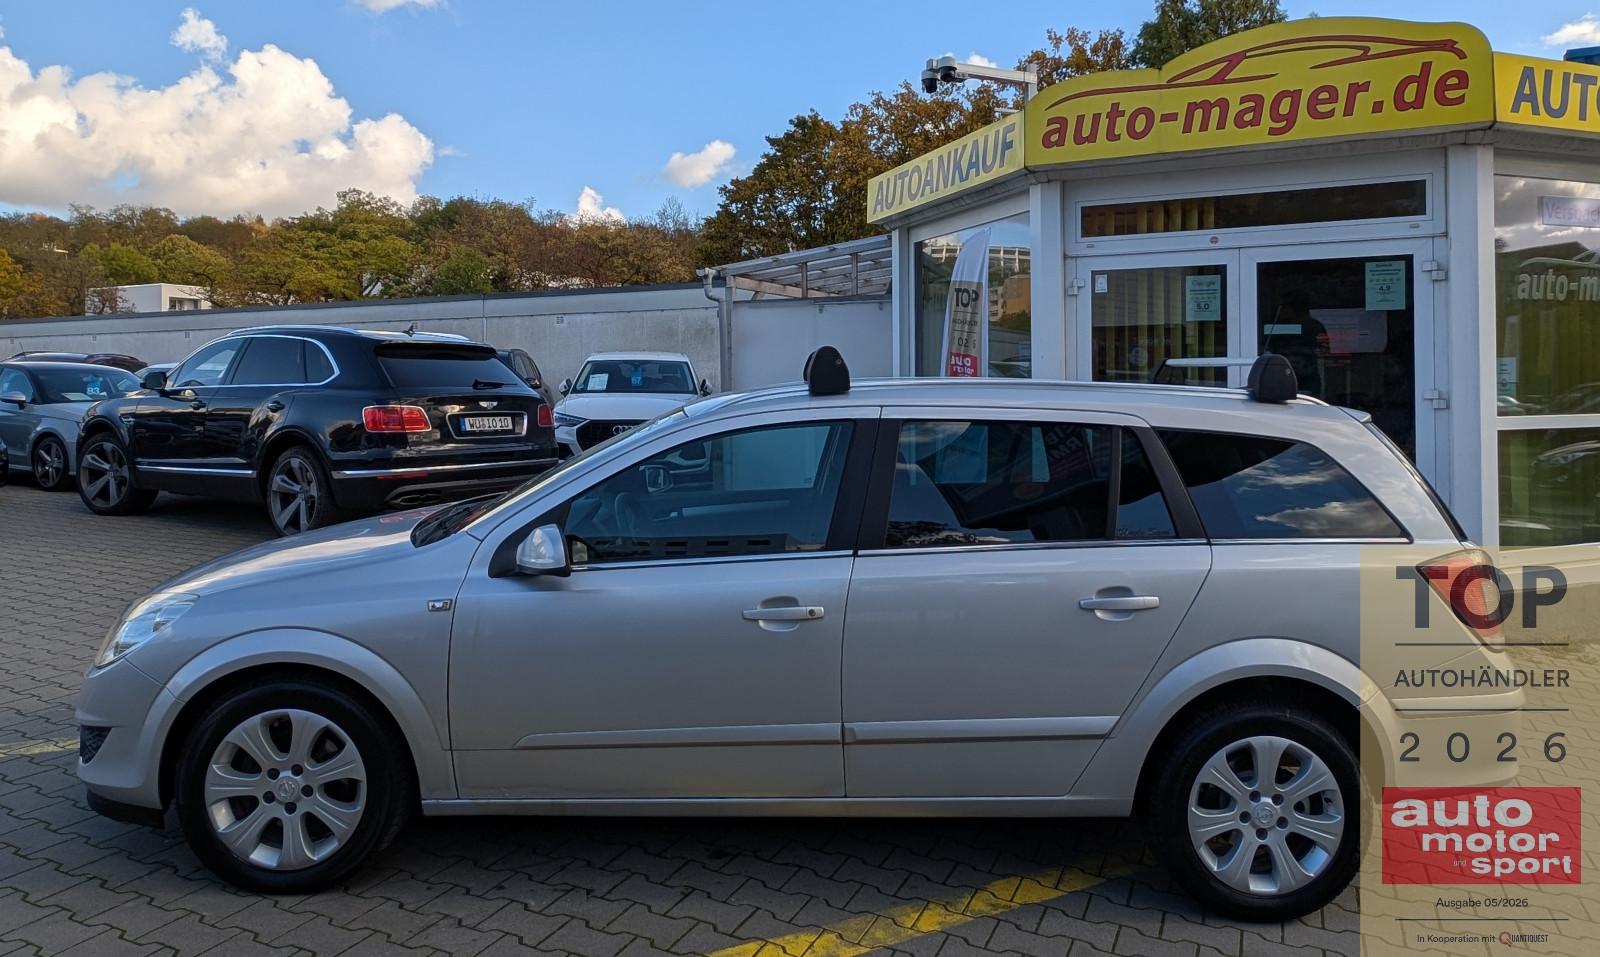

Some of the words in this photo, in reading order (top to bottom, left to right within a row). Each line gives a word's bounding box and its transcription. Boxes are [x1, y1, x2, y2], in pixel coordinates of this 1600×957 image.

[1041, 60, 1469, 150] auto-mager.de
[1510, 66, 1600, 121] AUT
[872, 124, 1016, 214] AUTOANKAUF
[1517, 268, 1600, 301] auto-m
